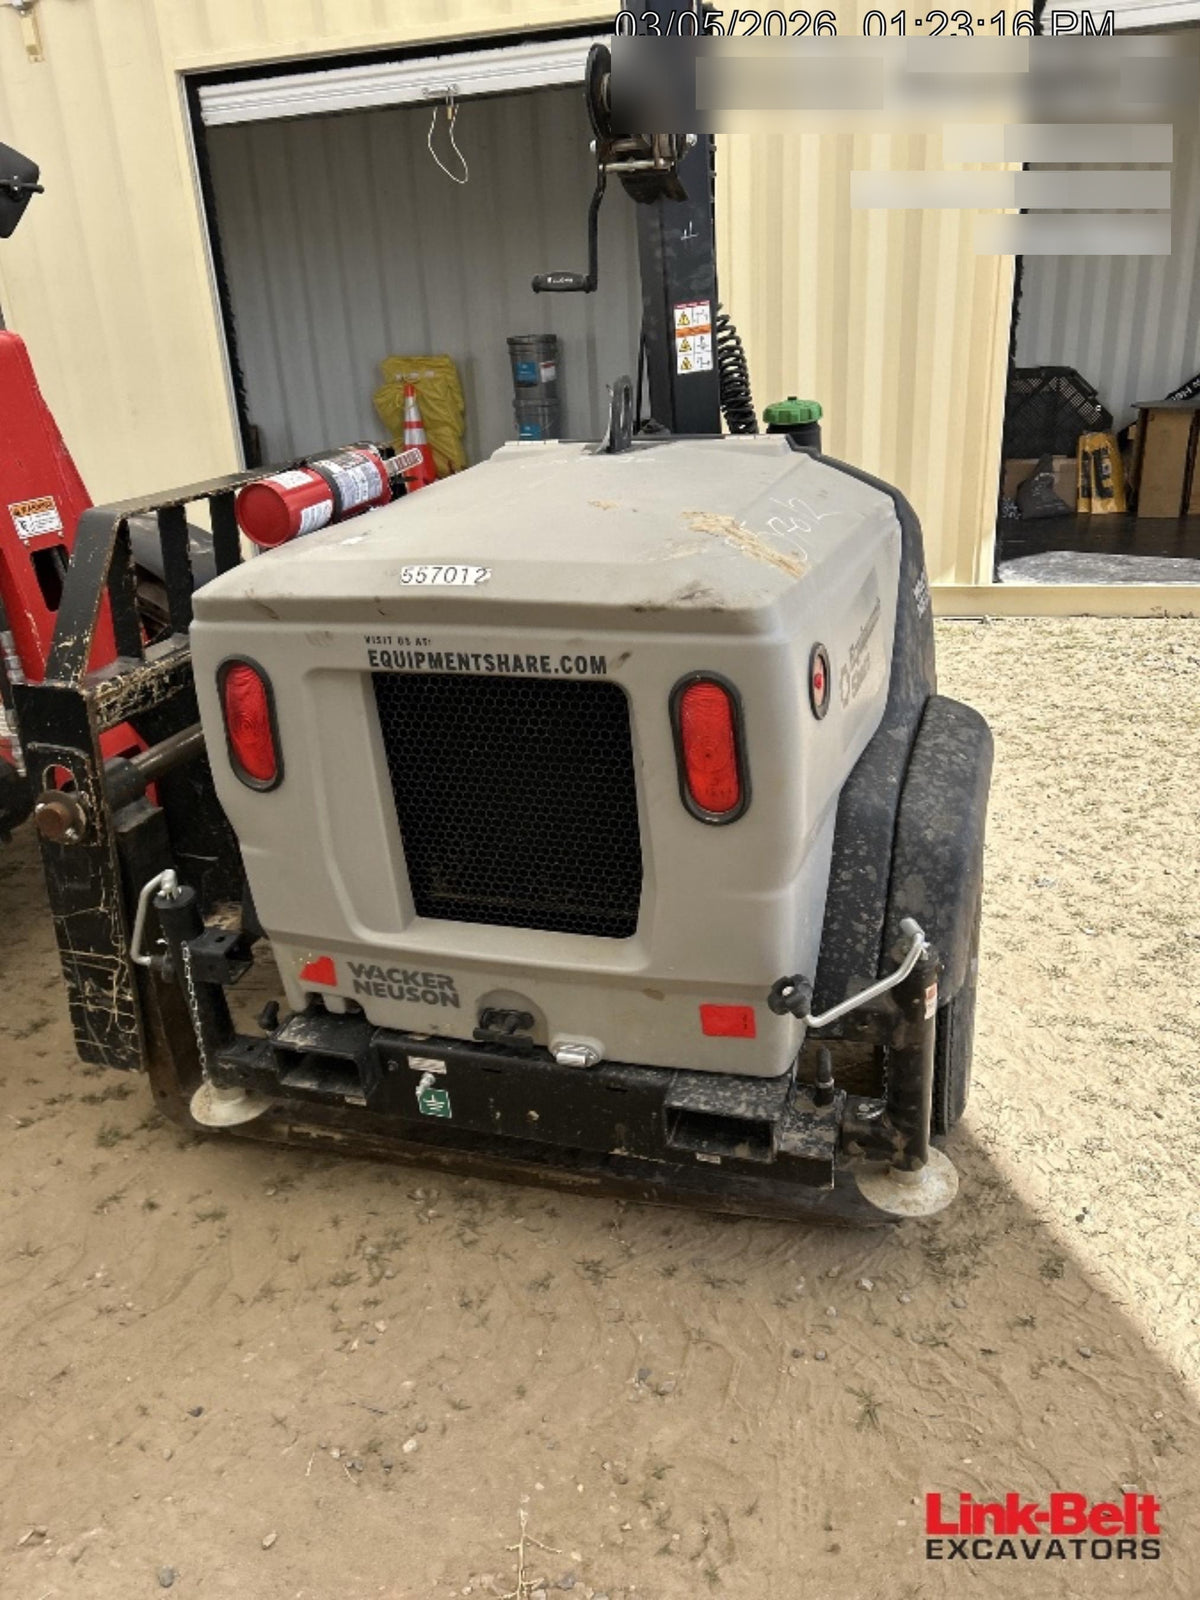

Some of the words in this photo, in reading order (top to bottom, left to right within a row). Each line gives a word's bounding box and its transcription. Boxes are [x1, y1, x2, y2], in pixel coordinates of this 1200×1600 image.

[401, 567, 488, 585] 557012
[364, 635, 392, 645] VISIT
[368, 650, 607, 675] EQUIPMENTSHARE.COM
[347, 961, 456, 992] WACKER
[352, 979, 461, 1009] NEUSON
